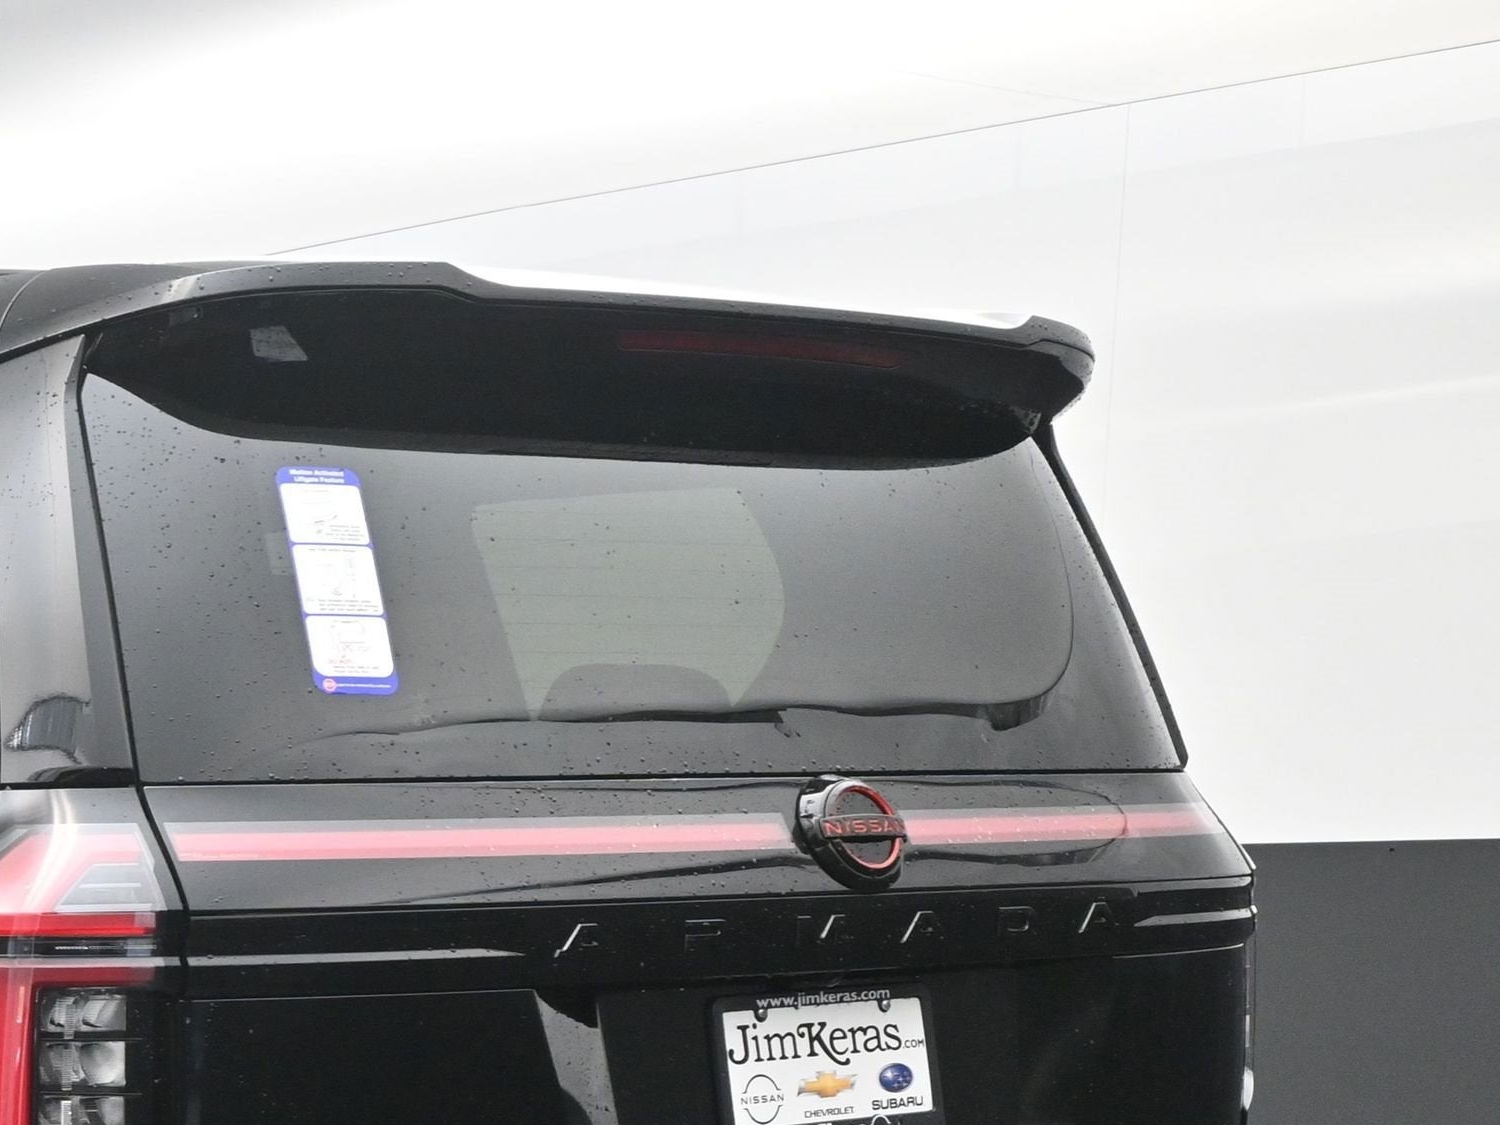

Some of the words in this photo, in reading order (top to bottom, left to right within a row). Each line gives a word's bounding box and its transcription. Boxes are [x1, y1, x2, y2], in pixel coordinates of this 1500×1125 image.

[824, 819, 903, 835] NISSAN
[756, 988, 891, 1009] www.jimkeras.com
[741, 1093, 784, 1105] NISSAN
[871, 1096, 924, 1110] SUBARU
[804, 1106, 854, 1118] CHEVROLET
